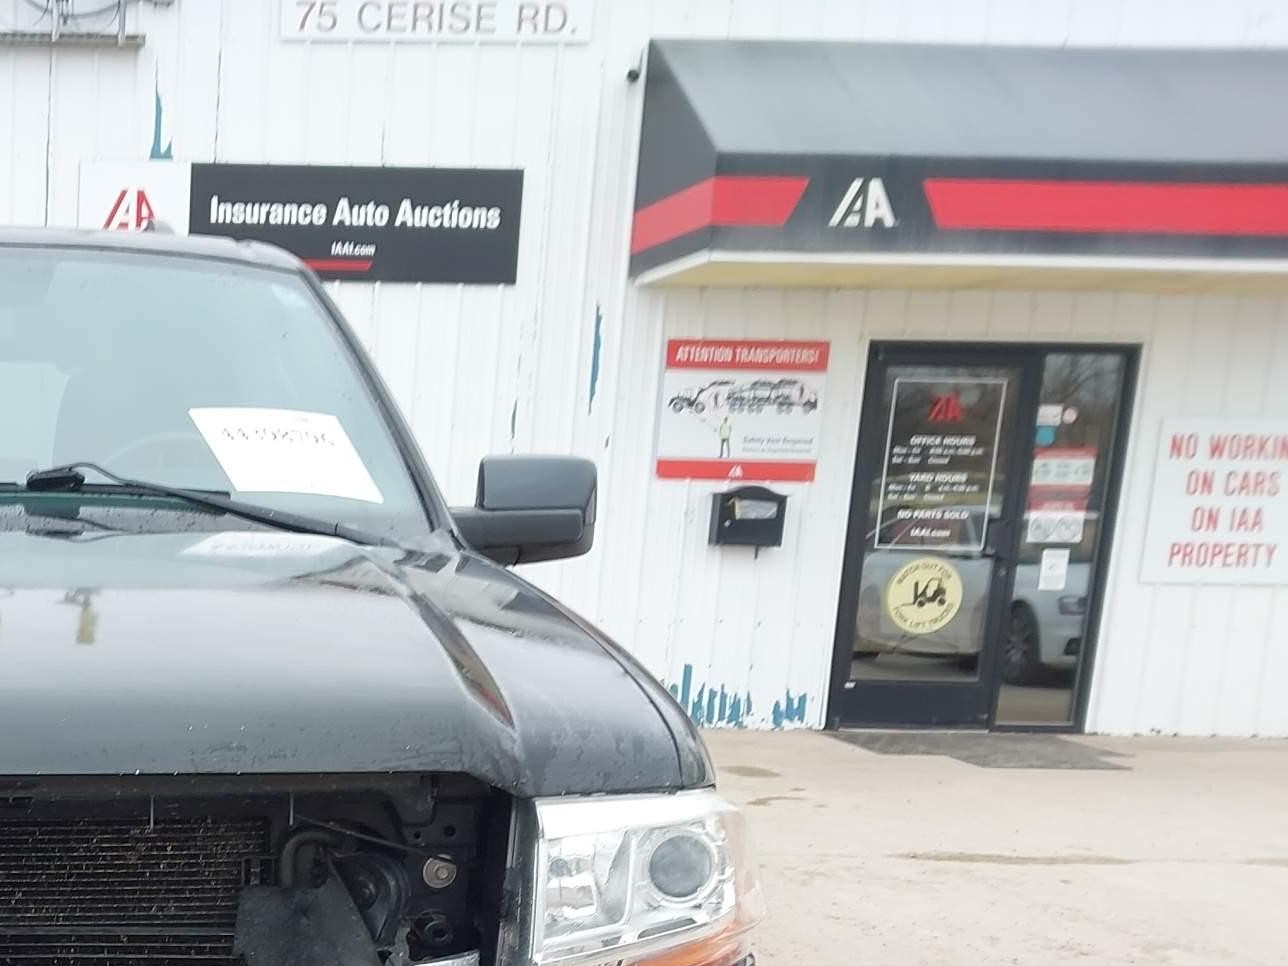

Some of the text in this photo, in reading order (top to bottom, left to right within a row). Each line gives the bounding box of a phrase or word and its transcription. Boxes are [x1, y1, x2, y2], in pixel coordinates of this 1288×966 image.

[295, 0, 577, 35] 75 CERISE RD.
[209, 194, 501, 230] Insurance Auto Auctions
[675, 345, 820, 365] ATTENTION TRANSPORTERS!
[910, 435, 976, 446] OFFICE HOURS
[1169, 432, 1199, 460] NO
[909, 472, 968, 483] YARD HOURS
[1186, 470, 1281, 497] ON CARS
[897, 510, 968, 520] NO PARTS SOLD
[1192, 506, 1263, 533] ON IAA
[1168, 542, 1278, 568] PROPERTY
